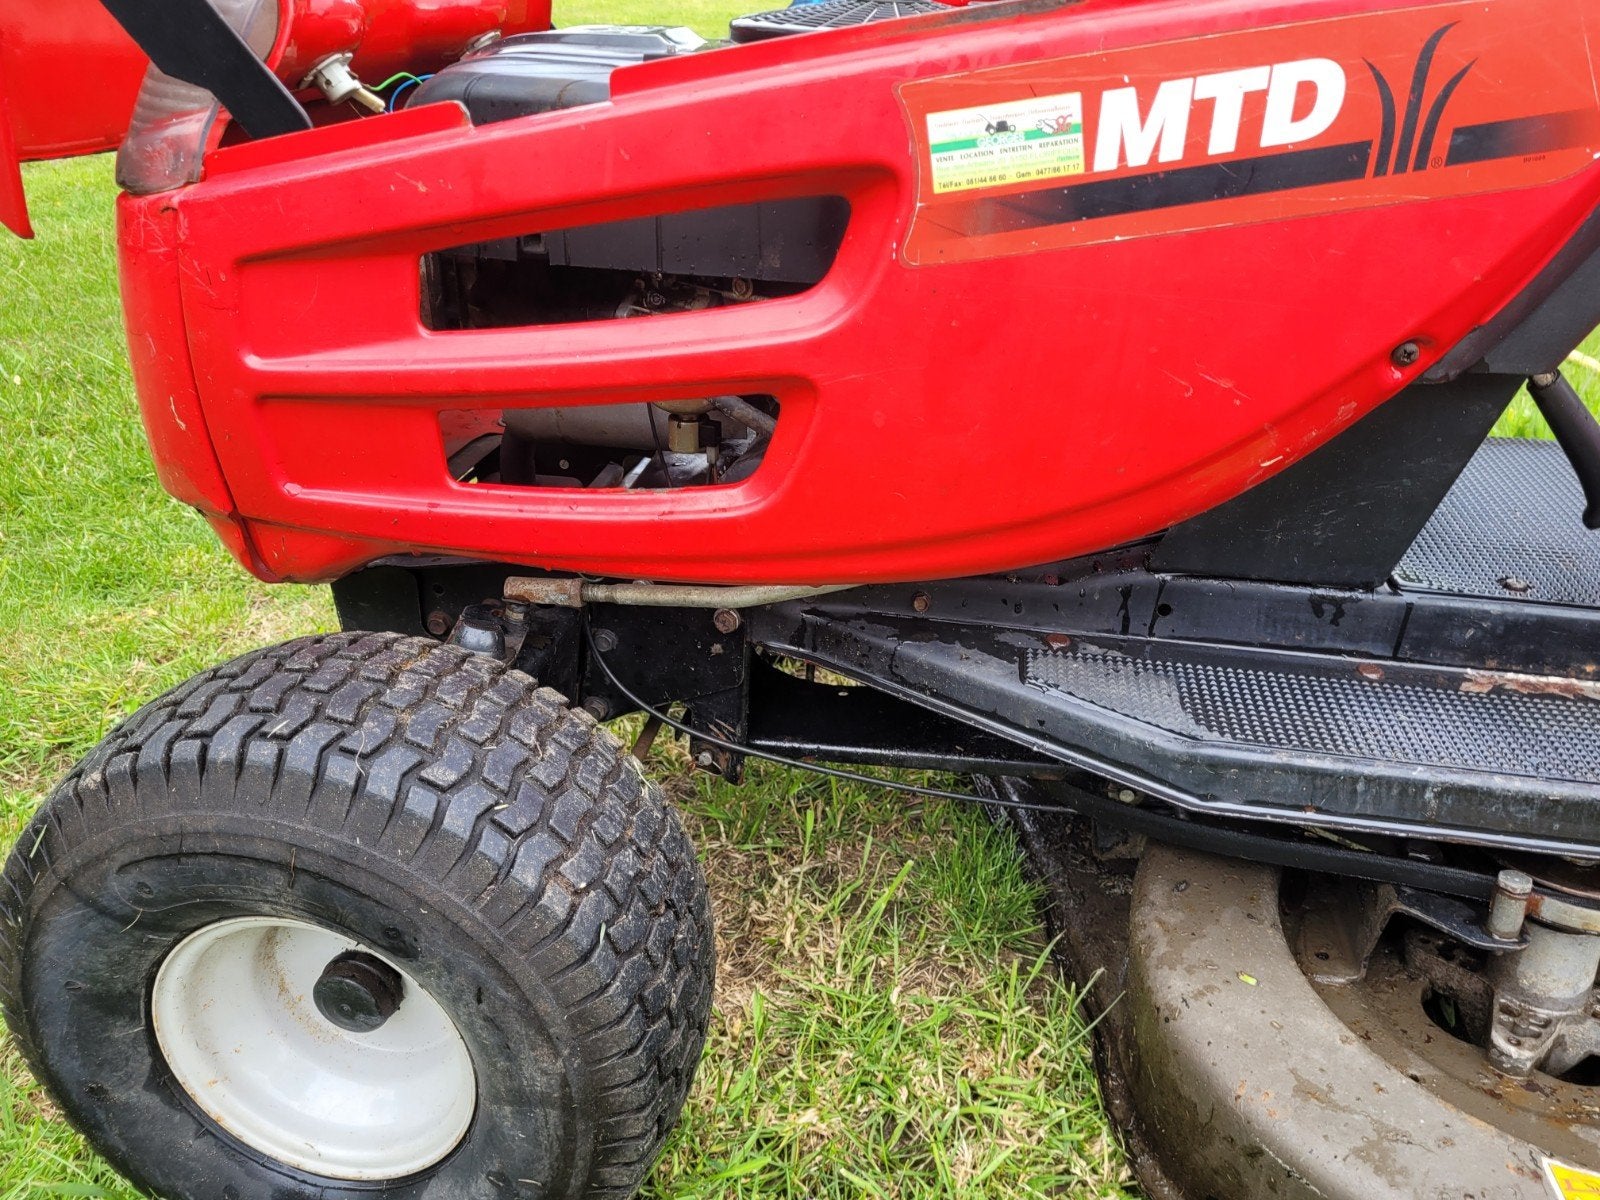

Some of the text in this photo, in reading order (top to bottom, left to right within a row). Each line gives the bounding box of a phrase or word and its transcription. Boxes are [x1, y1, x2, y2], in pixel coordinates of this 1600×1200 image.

[1093, 58, 1346, 171] MTD
[935, 137, 1079, 163] VENTE LOCATION ENTRETIEN REPARATION
[976, 131, 1026, 148] GEORGES
